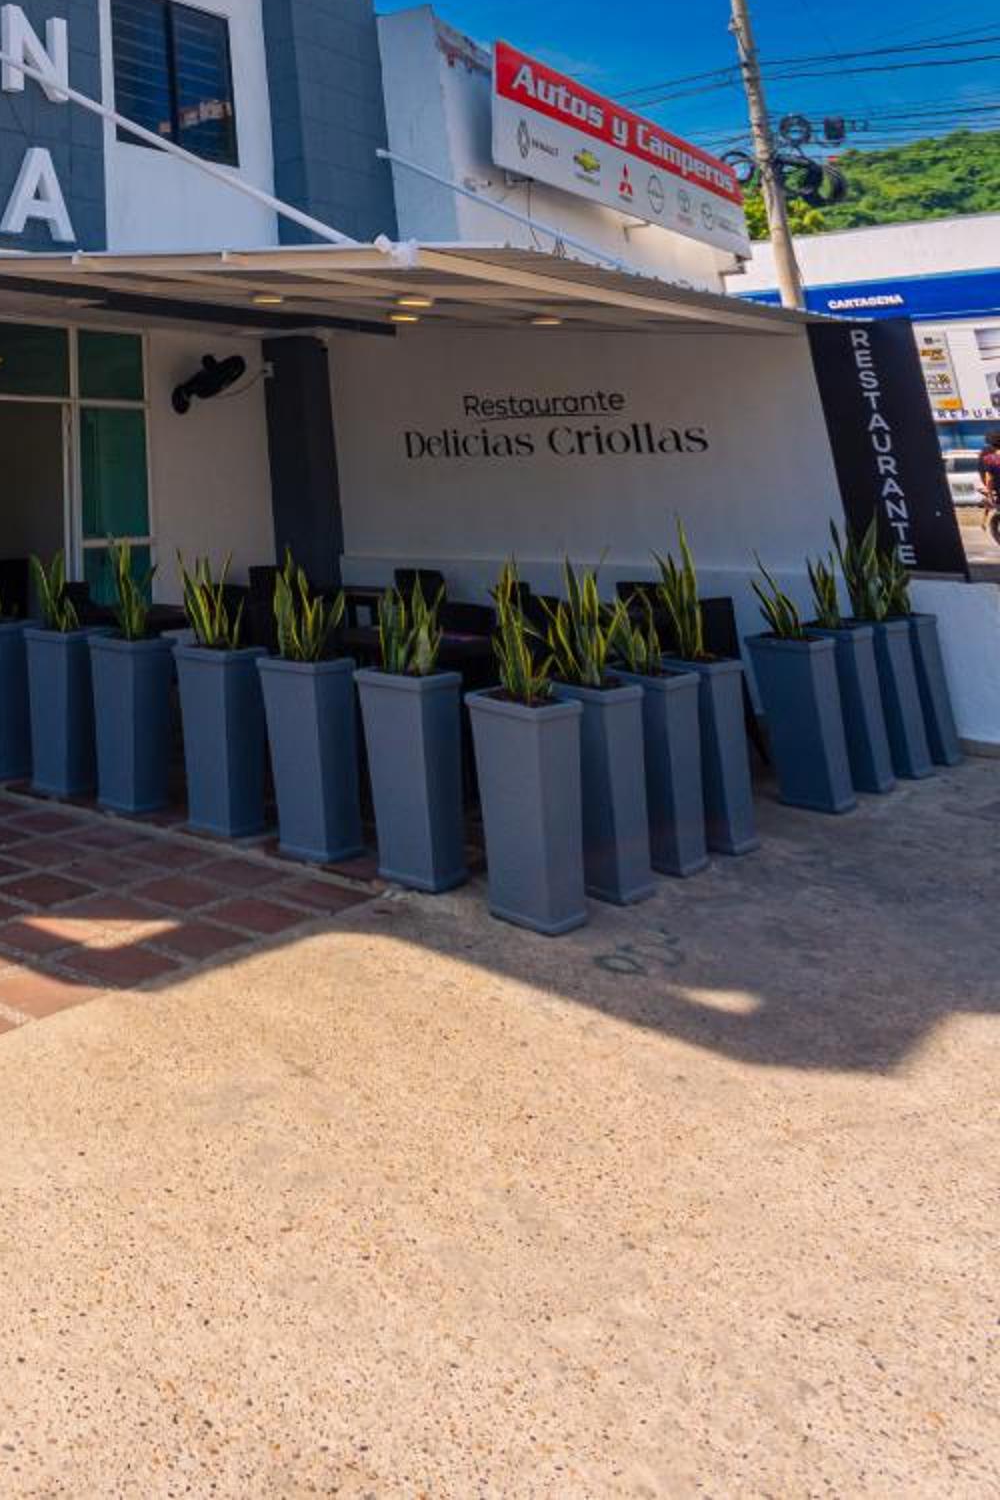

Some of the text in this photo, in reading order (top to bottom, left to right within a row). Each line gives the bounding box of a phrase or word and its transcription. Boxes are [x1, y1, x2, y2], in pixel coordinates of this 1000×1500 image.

[511, 64, 734, 193] Autos y Camperos
[827, 294, 904, 309] CARTAGENA
[463, 391, 625, 417] Restaurante
[404, 423, 710, 459] Delicias Criollas
[851, 329, 918, 565] RESTAURANTE
